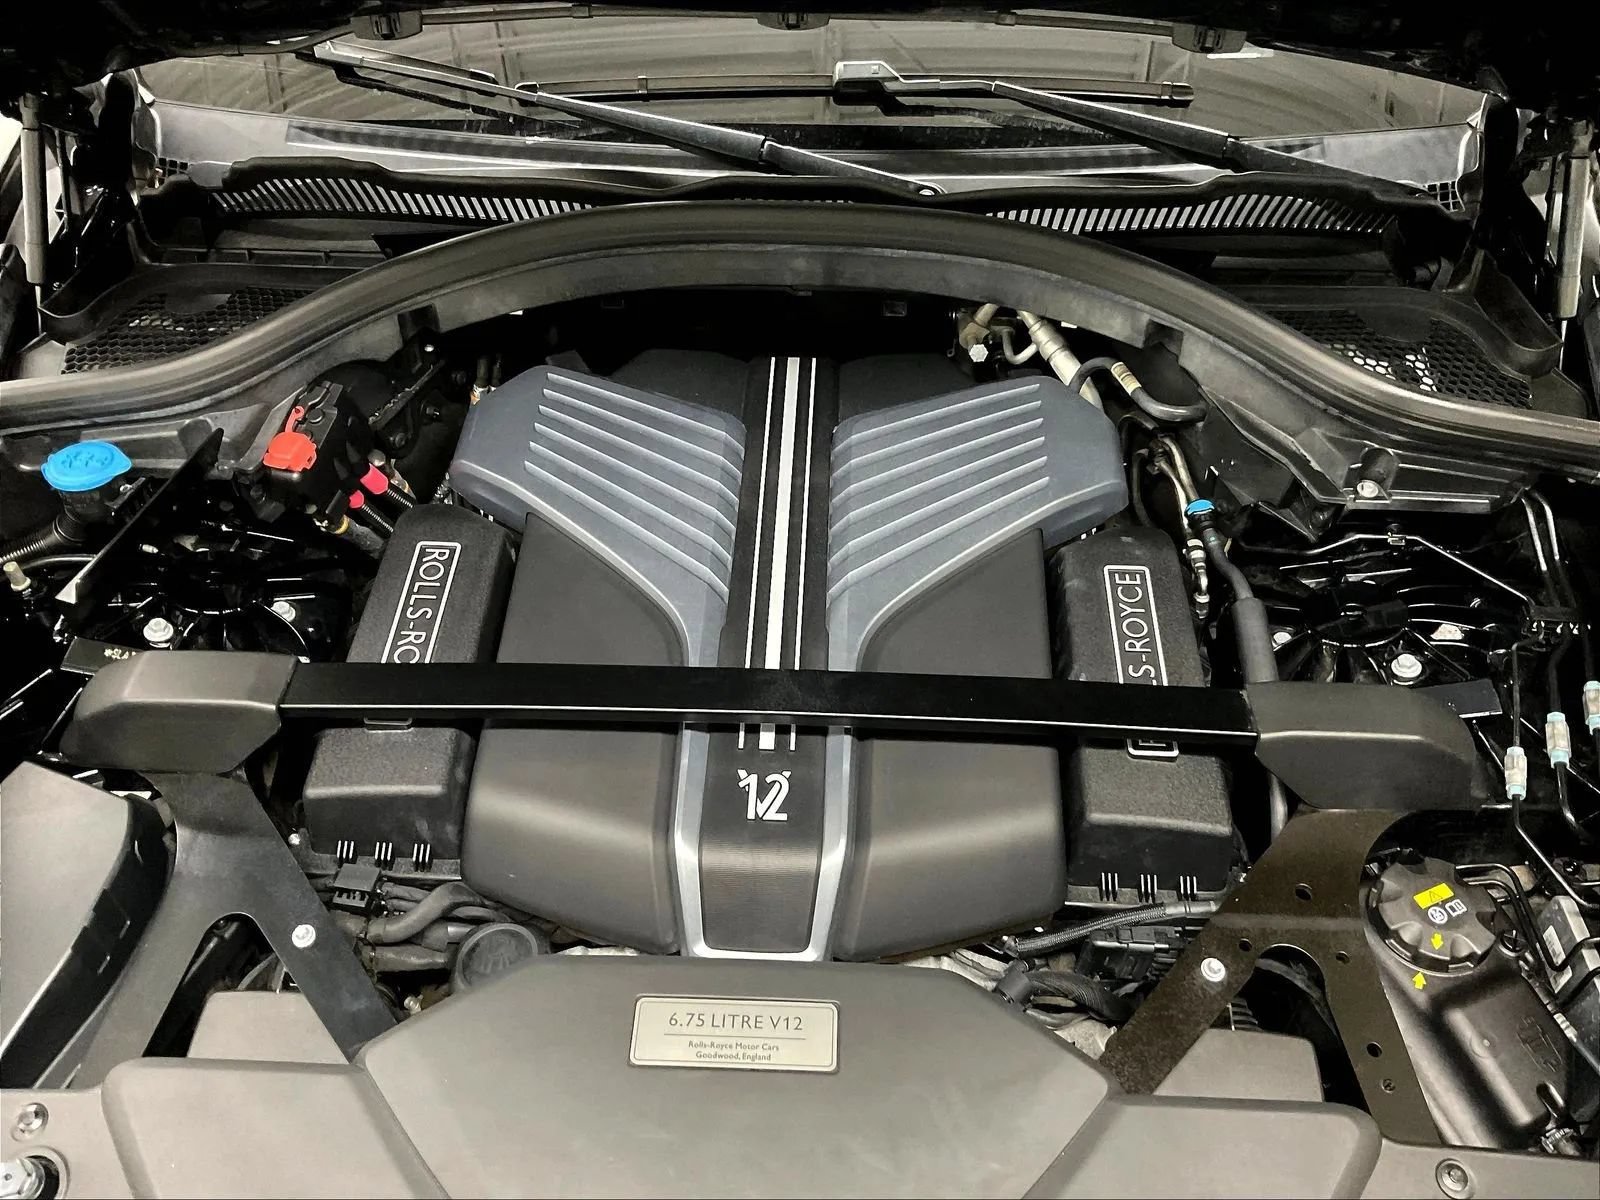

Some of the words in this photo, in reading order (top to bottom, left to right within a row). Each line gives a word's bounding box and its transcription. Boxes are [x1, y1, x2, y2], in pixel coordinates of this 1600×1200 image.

[393, 548, 450, 663] ROLLS-RO
[1114, 573, 1157, 686] S-ROYCE
[668, 1012, 705, 1028] 6.75
[711, 1014, 764, 1030] LITRE
[769, 1016, 803, 1031] V12
[688, 1040, 733, 1050] Rolls-Royce
[735, 1042, 759, 1050] Motor
[761, 1043, 779, 1051] Cars
[695, 1051, 741, 1060] Goodwood,
[742, 1052, 772, 1062] England
